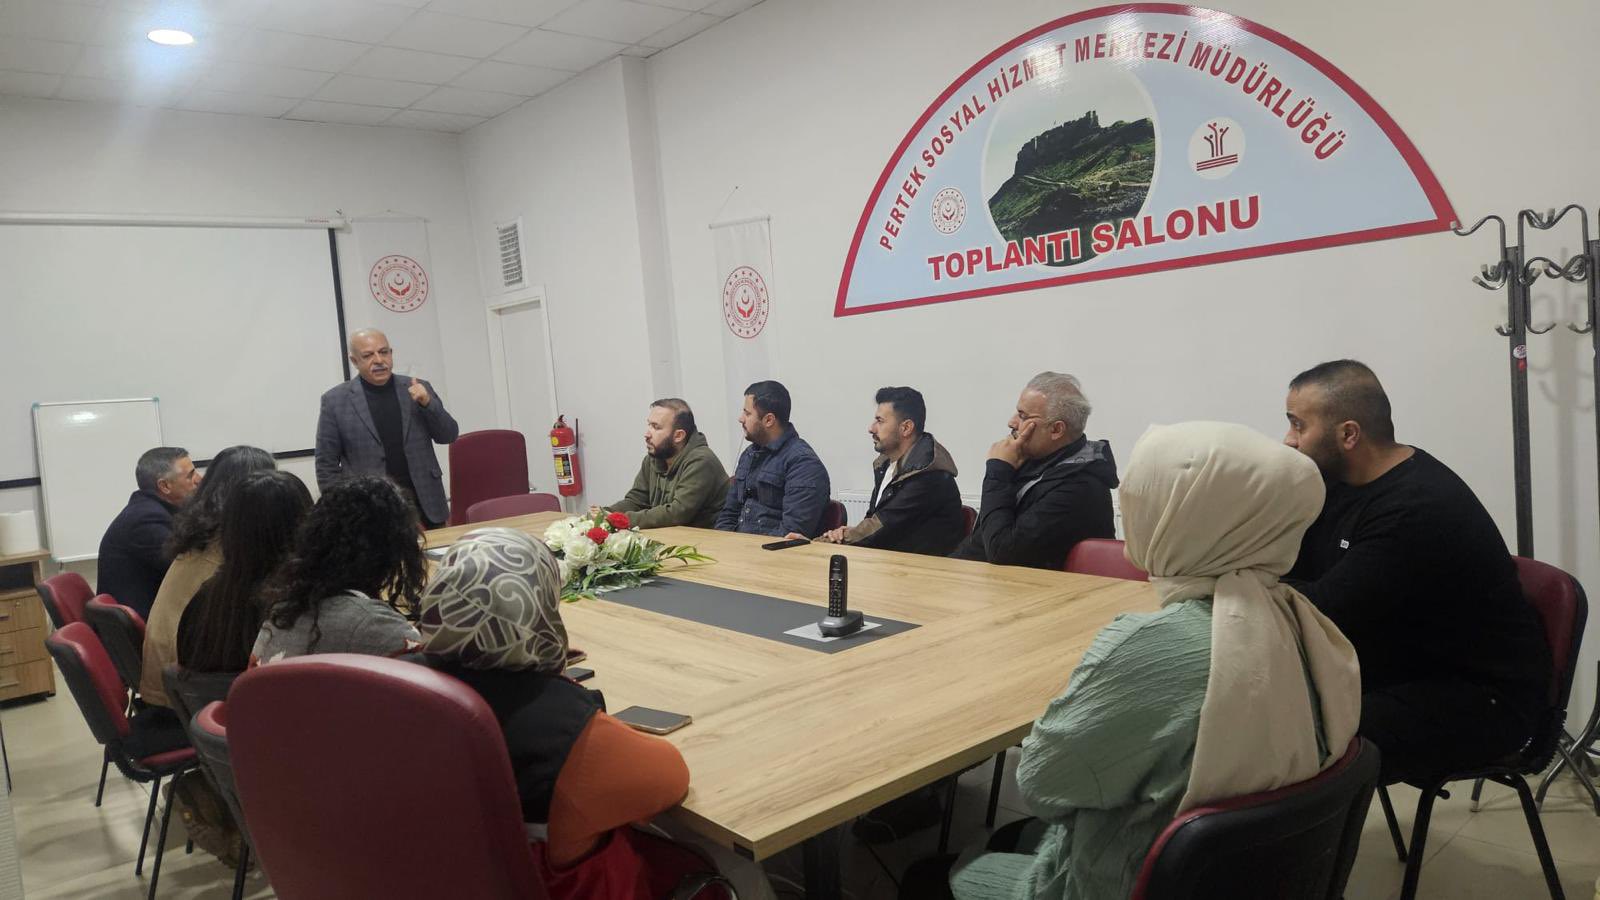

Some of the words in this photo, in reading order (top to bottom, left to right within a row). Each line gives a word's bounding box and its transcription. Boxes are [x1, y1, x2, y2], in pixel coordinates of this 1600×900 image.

[879, 167, 926, 250] PERTEK
[922, 95, 986, 168] SOSYAL
[987, 43, 1066, 103] HİZMT
[1075, 31, 1188, 63] MEEZİ
[1188, 41, 1346, 160] MÜDÜRLÜĞÜ
[928, 229, 1080, 281] TOPLANTI
[1092, 195, 1260, 255] SALONU
